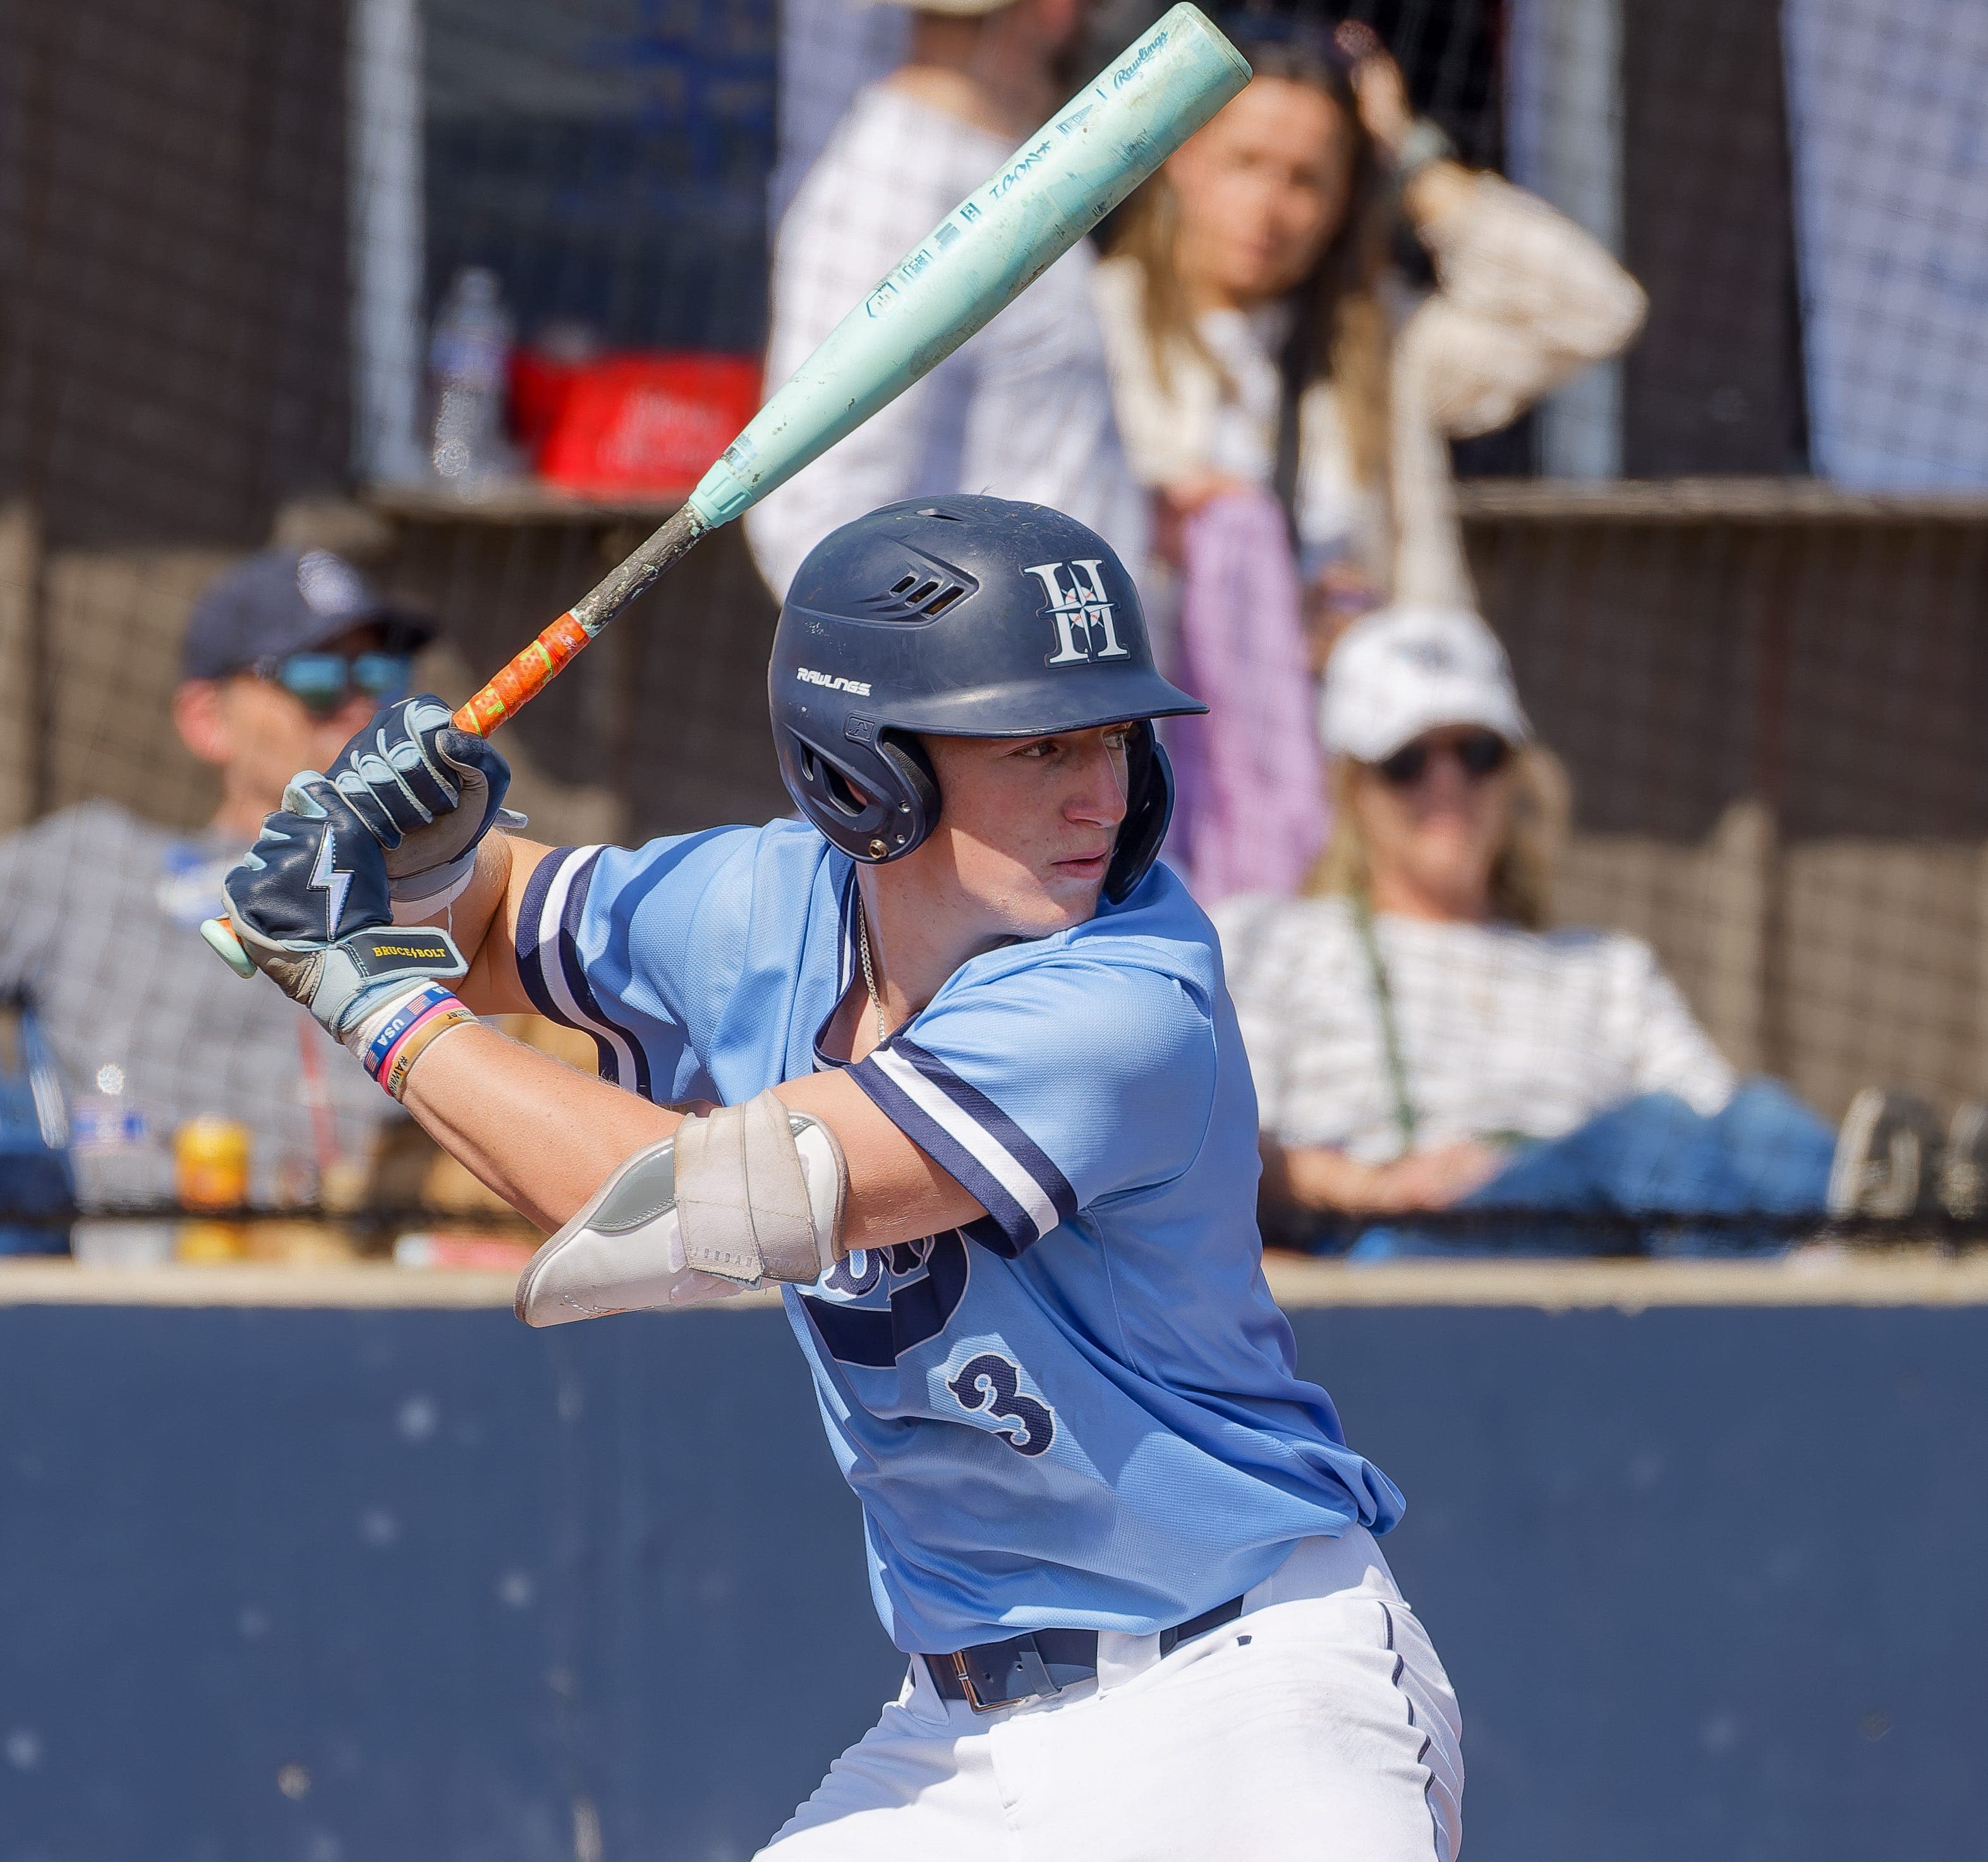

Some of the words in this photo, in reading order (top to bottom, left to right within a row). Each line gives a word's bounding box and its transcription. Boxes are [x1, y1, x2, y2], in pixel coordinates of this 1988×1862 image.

[1113, 30, 1168, 91] Rawlings
[796, 667, 872, 697] RAWLINGS
[377, 1018, 405, 1047] USA
[945, 1351, 1056, 1458] 3
